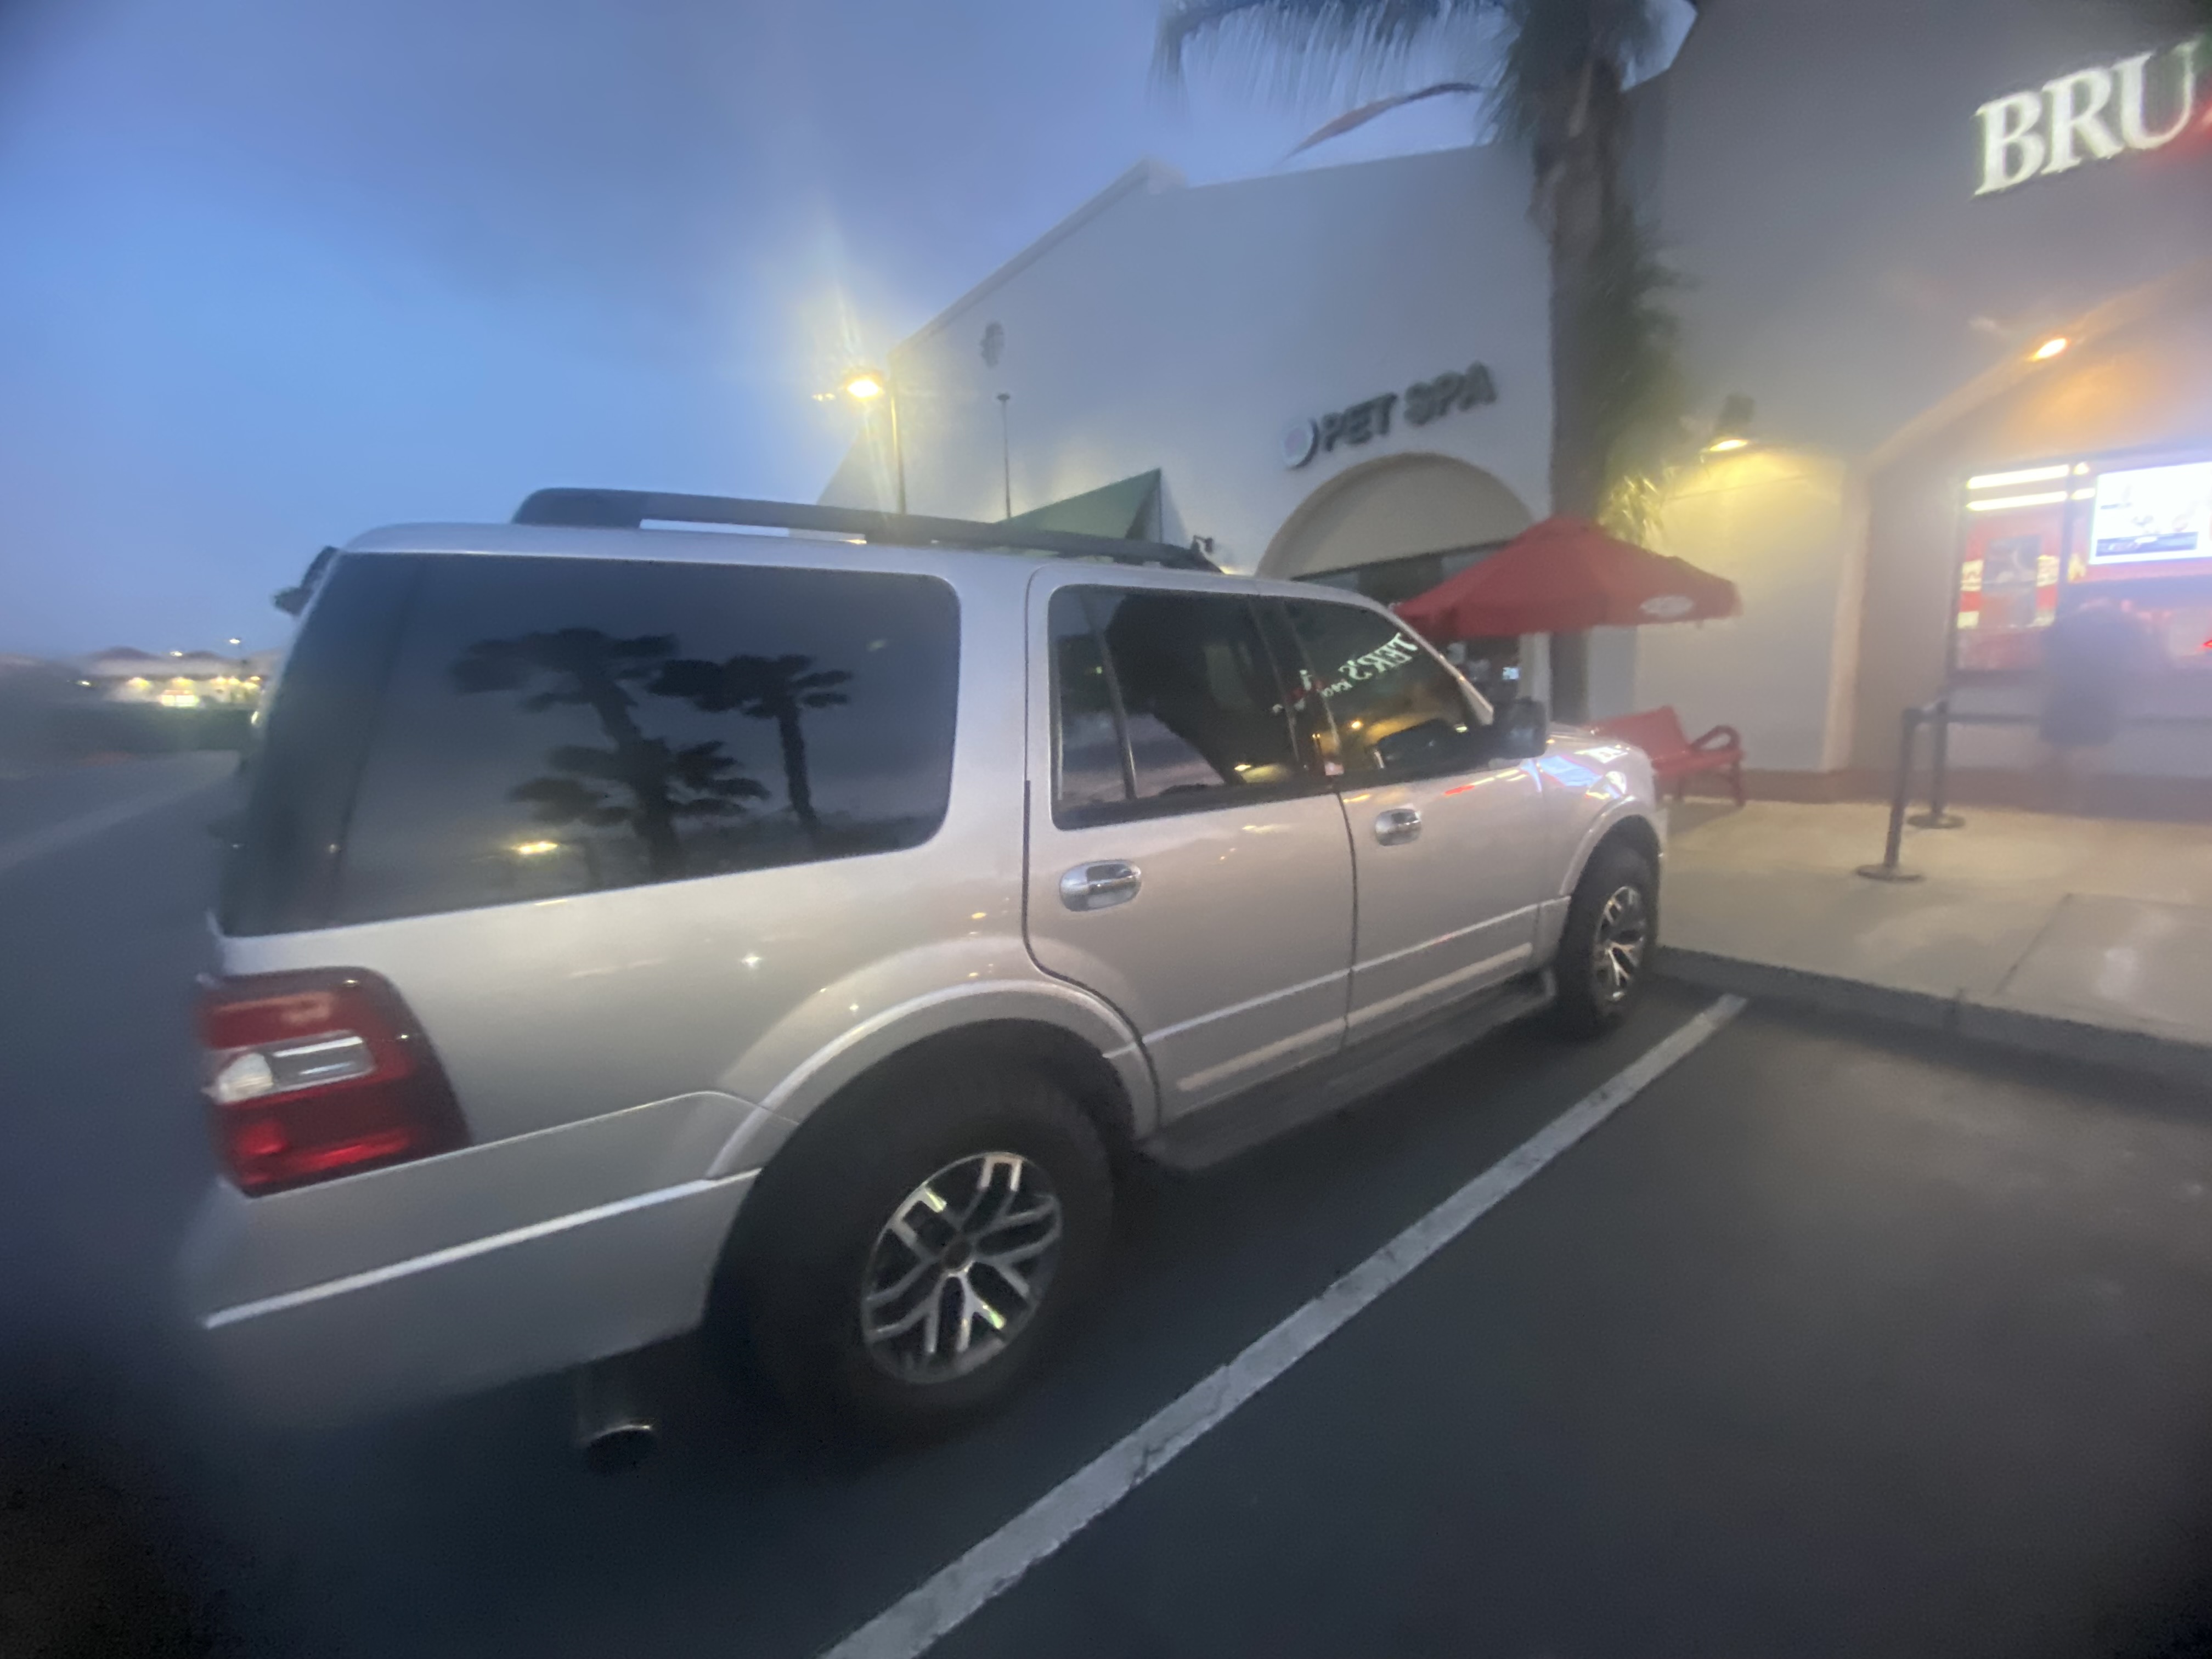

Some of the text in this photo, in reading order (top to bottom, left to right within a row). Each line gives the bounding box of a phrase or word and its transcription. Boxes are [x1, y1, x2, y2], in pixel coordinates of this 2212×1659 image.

[1972, 36, 2201, 196] BRU
[1321, 360, 1497, 452] PET SPA
